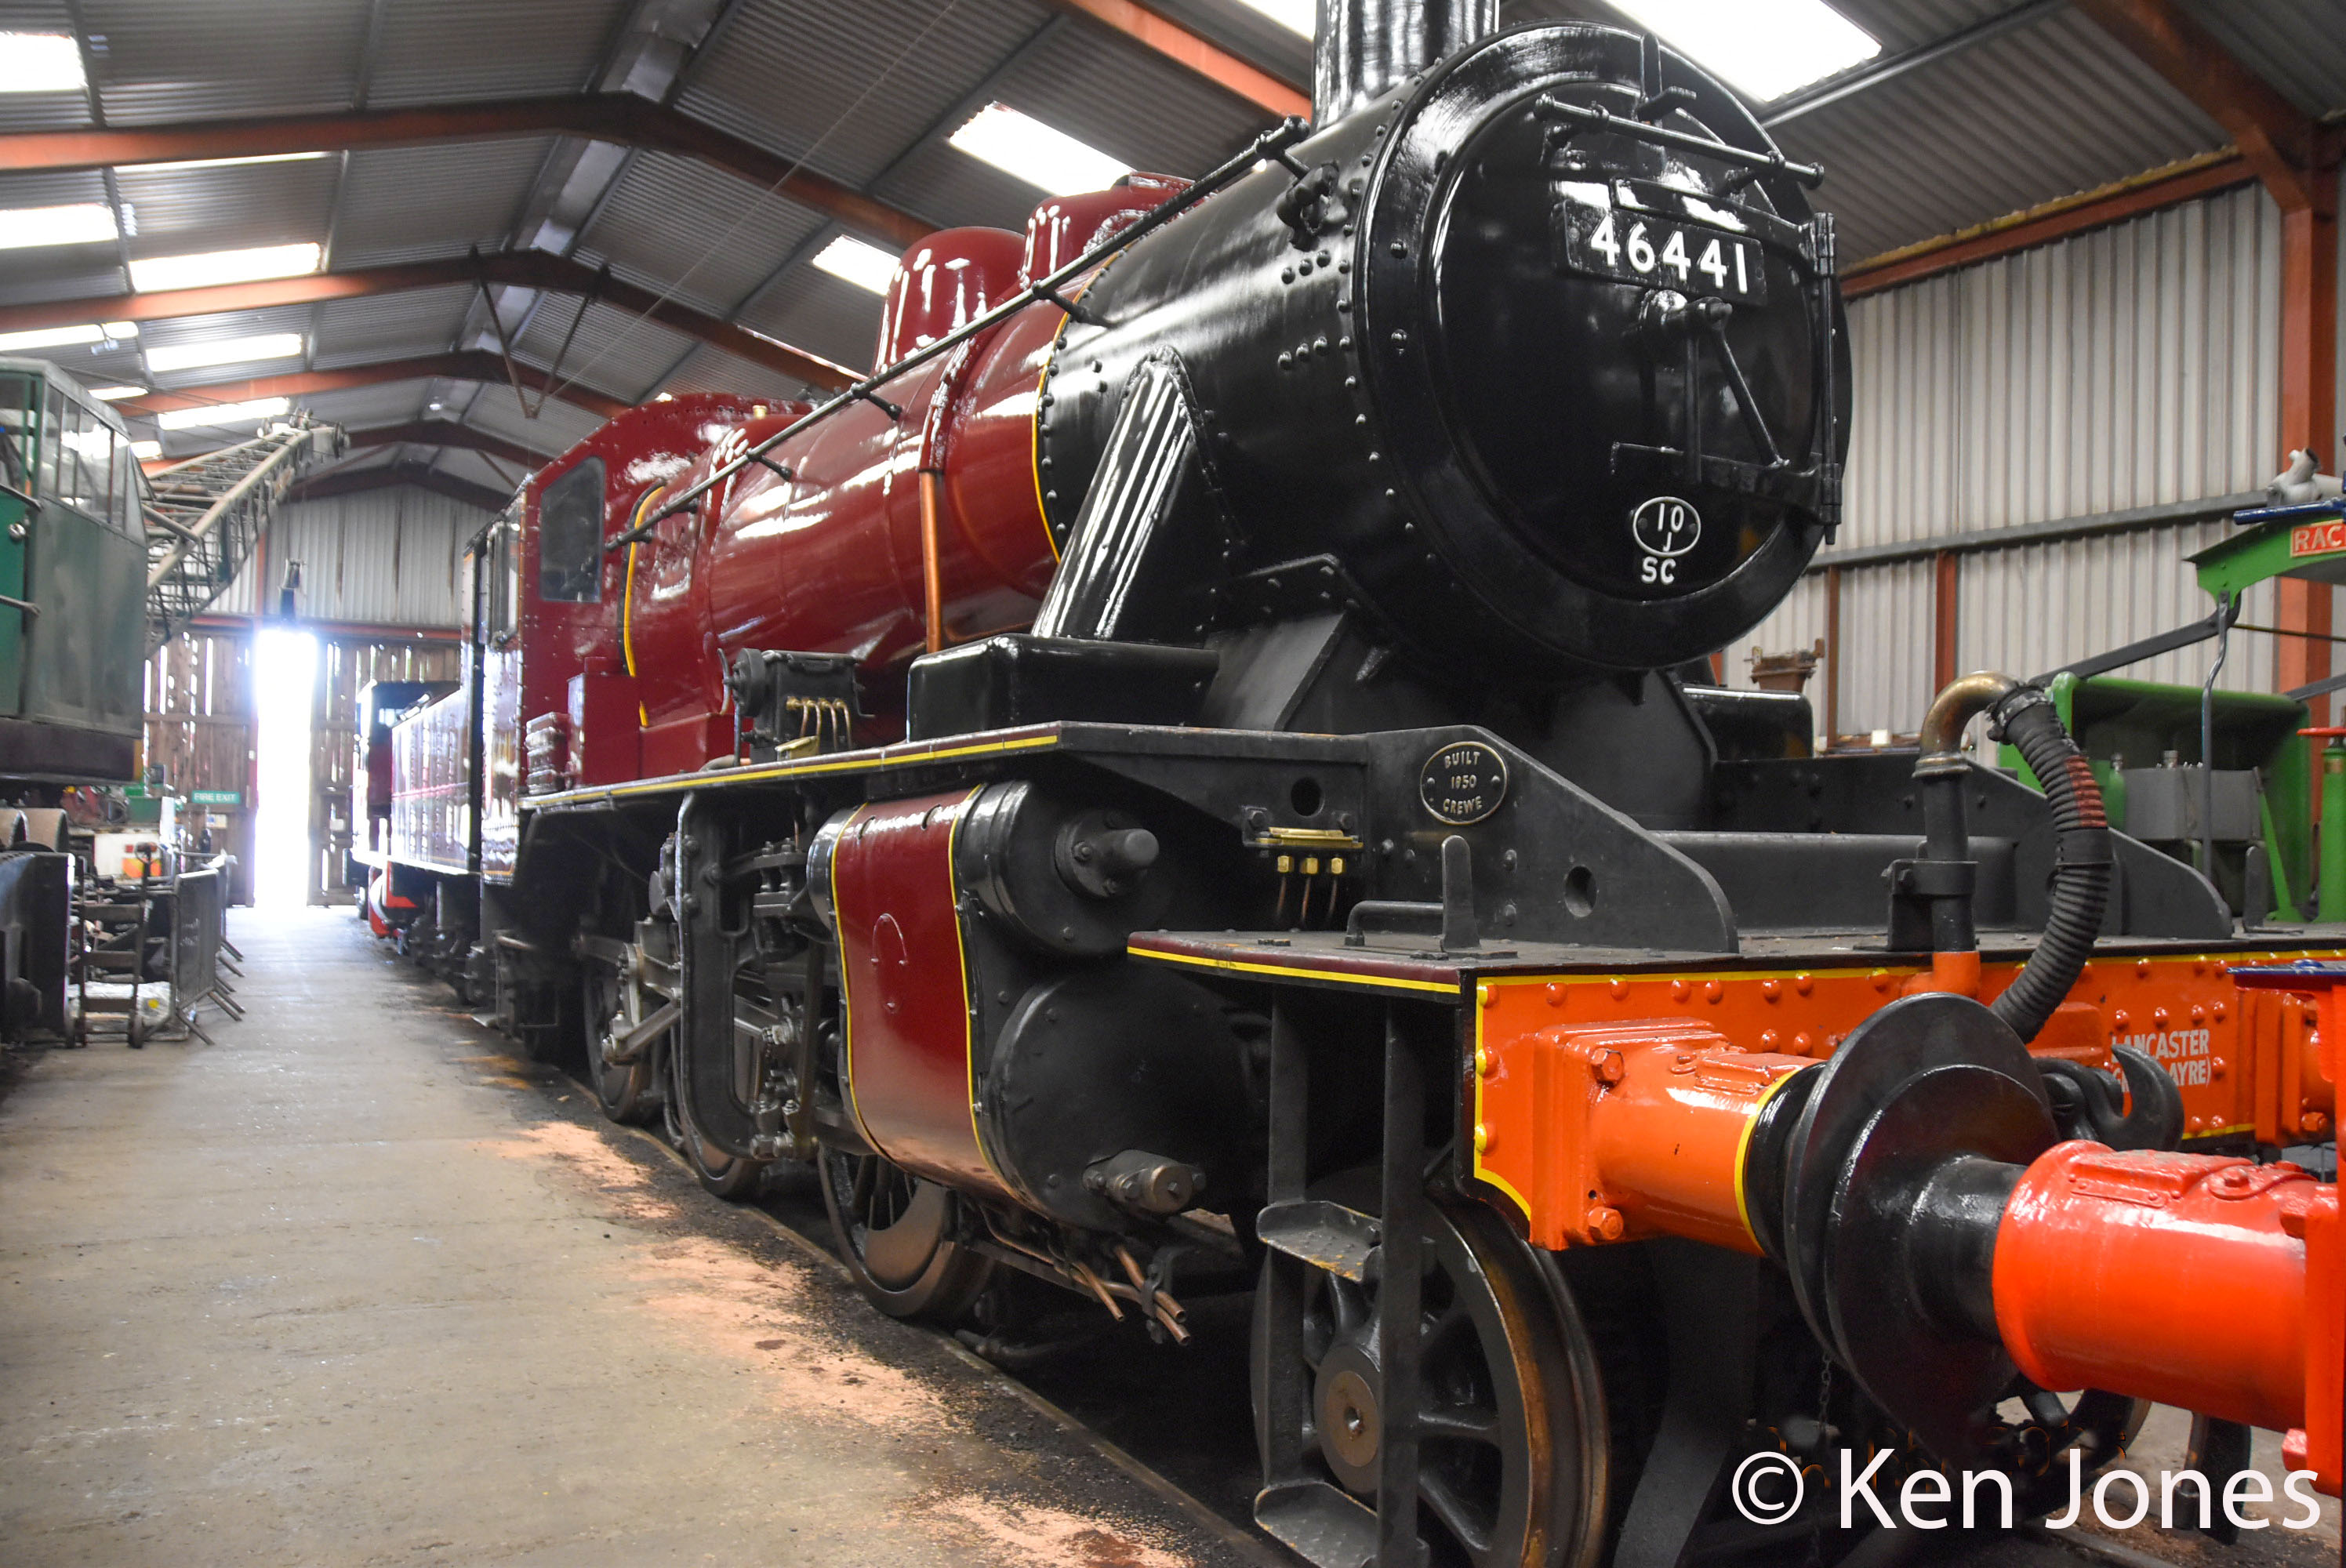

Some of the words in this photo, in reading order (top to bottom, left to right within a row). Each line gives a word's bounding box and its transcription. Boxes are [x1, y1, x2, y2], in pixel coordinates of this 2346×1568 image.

[1589, 214, 1748, 294] 46441
[1657, 503, 1685, 533] 10
[2294, 524, 2346, 552] RAC
[1641, 556, 1676, 585] SC
[1444, 750, 1480, 769] BUILT
[1451, 774, 1477, 789] 1950
[194, 793, 214, 801] FIRE
[216, 793, 236, 801] EXIT
[1443, 795, 1483, 815] CREWE
